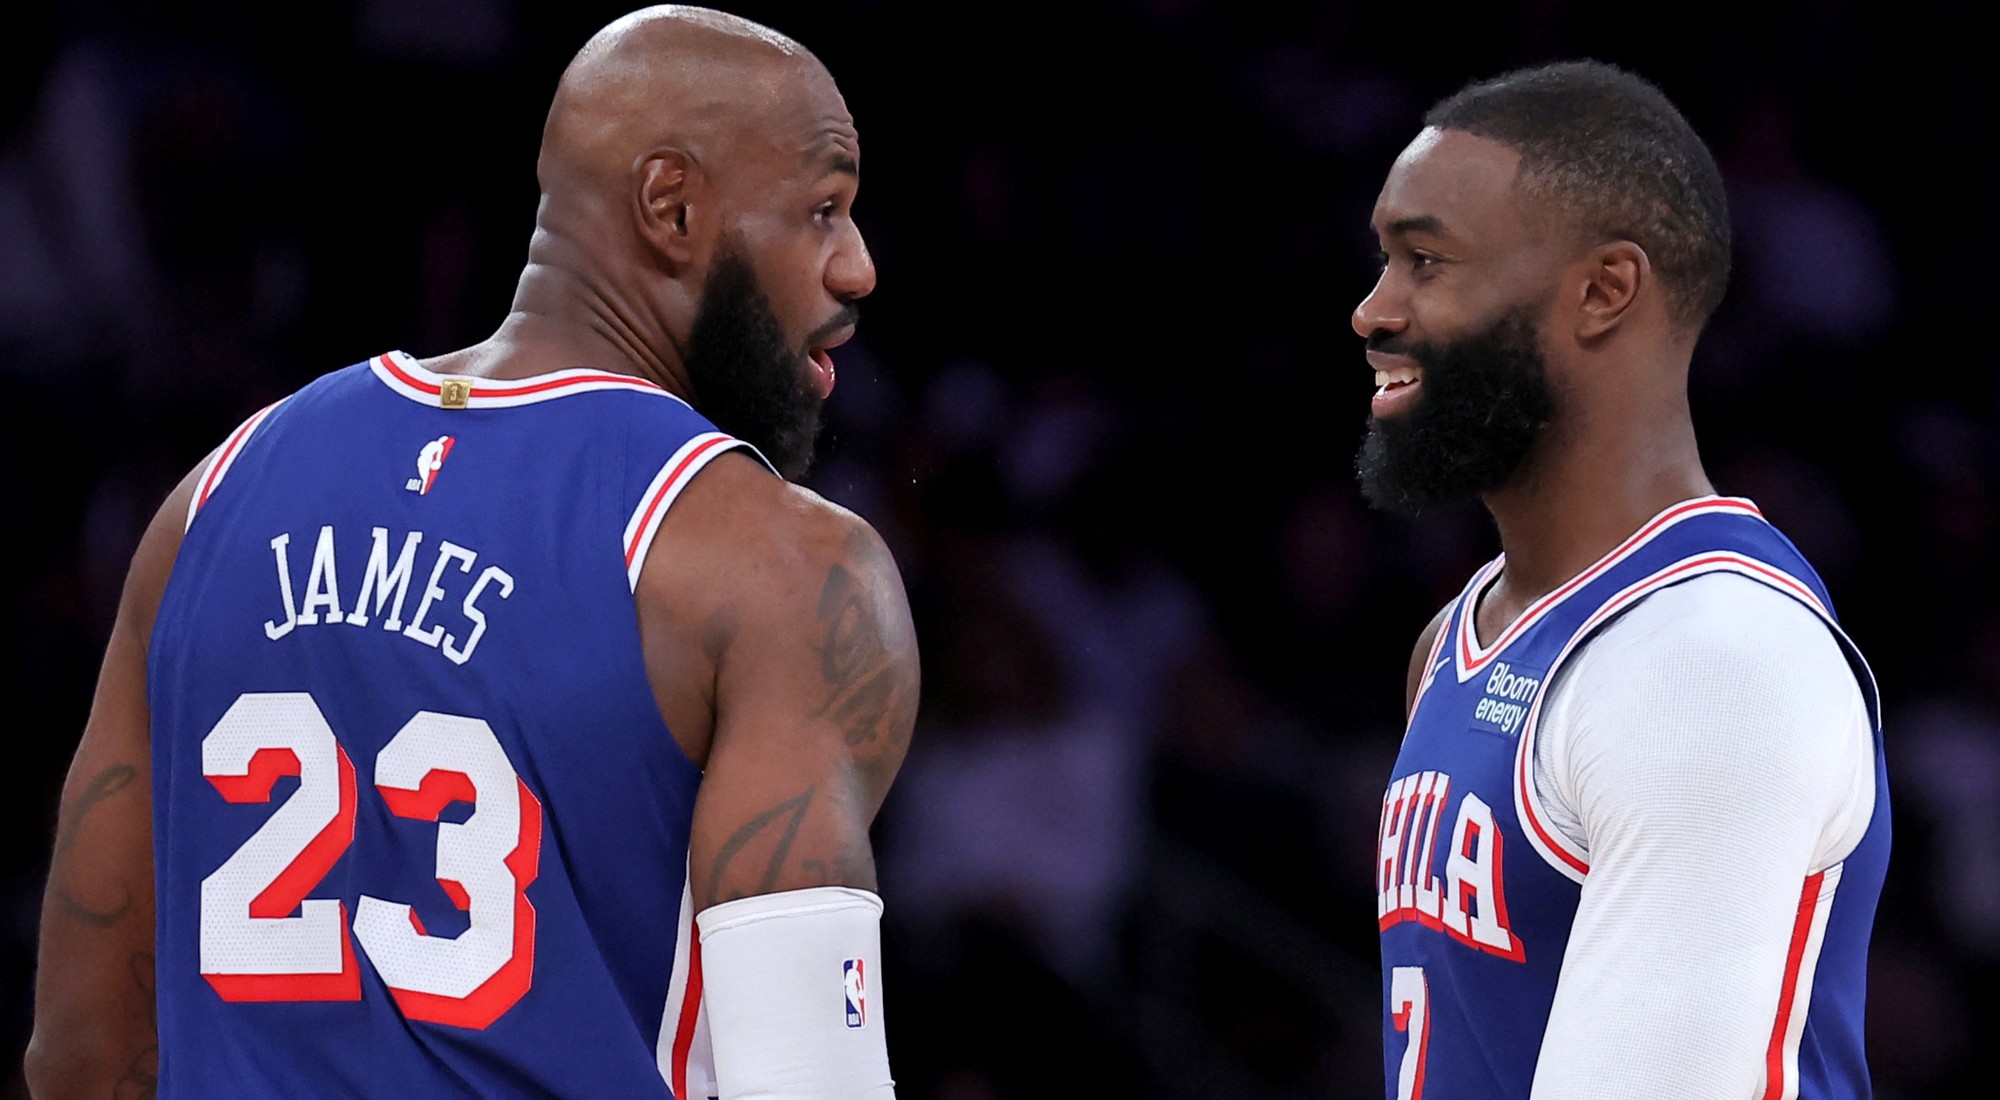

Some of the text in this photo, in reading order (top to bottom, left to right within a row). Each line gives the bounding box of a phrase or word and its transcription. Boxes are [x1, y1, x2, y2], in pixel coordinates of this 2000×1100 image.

[265, 526, 514, 665] JAMES
[1474, 697, 1527, 734] energy
[1485, 662, 1539, 703] Bloom
[201, 692, 541, 1029] 23
[1376, 770, 1526, 963] HILA
[1391, 966, 1430, 1100] 7
